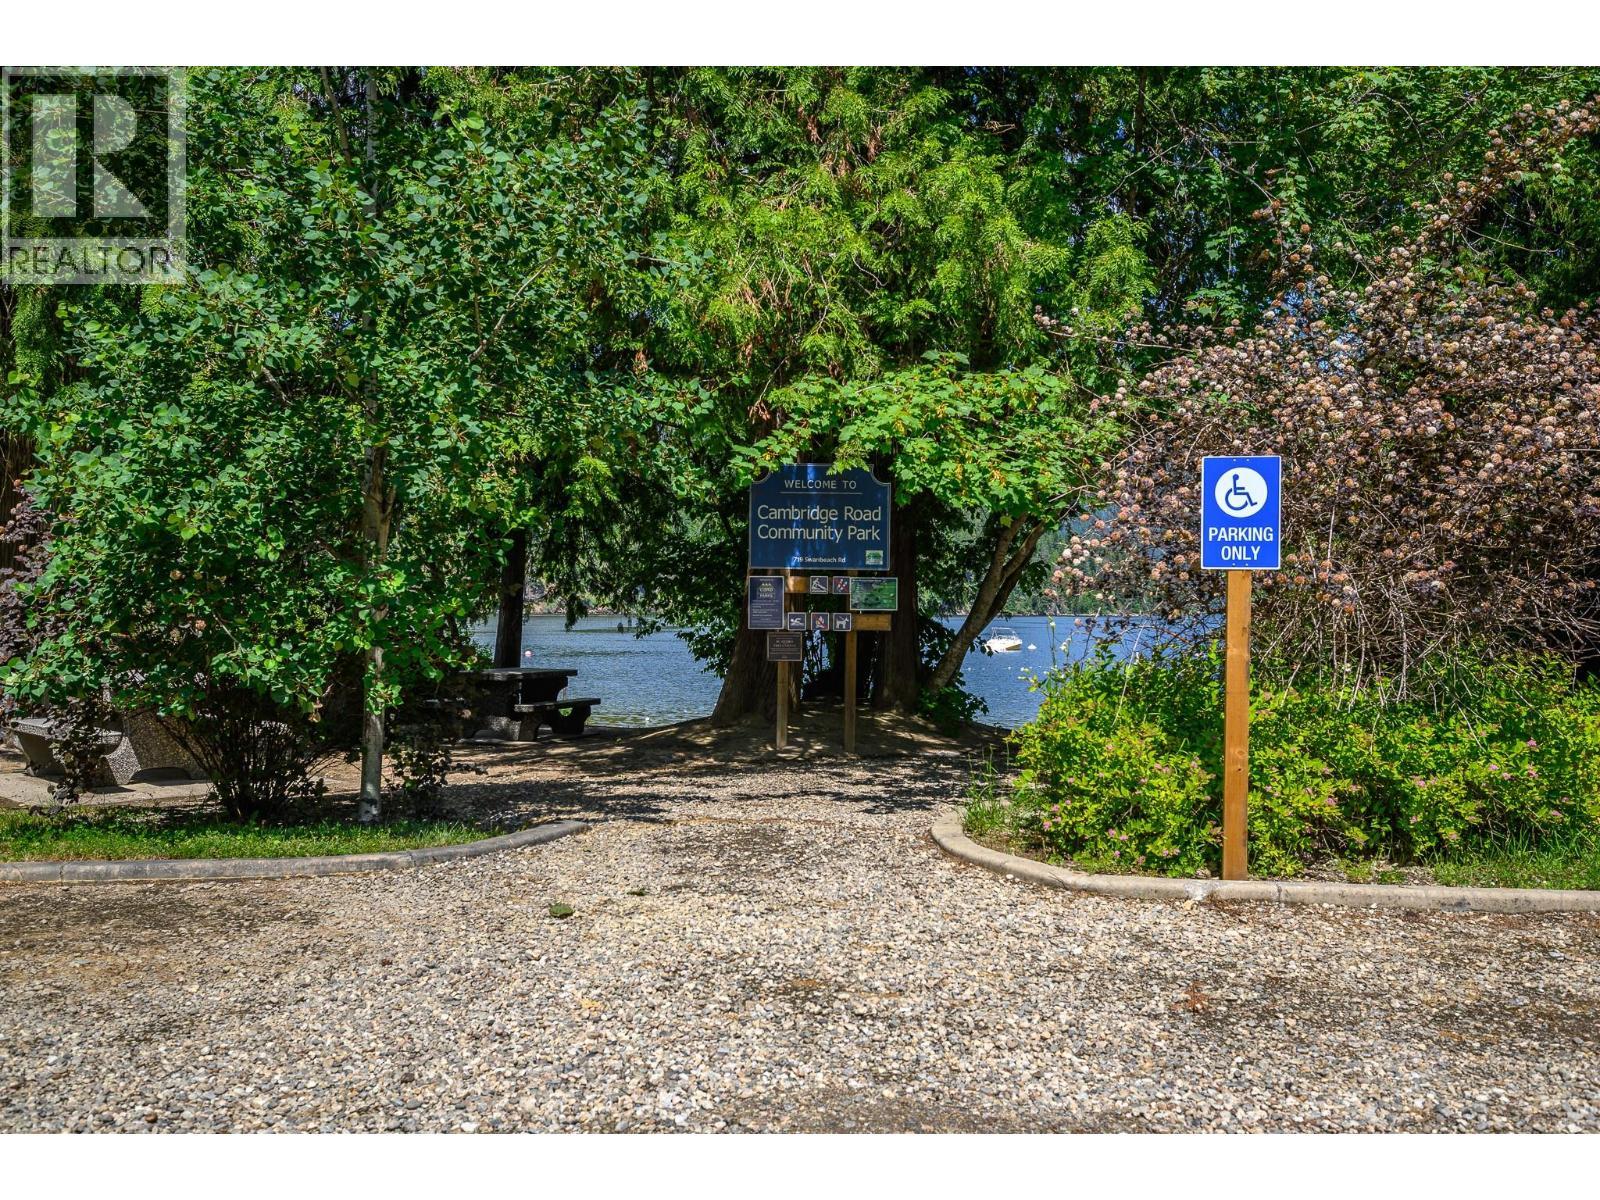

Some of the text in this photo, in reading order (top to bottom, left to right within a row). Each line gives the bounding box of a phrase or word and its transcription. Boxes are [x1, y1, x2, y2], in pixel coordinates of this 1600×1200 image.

[784, 479, 857, 490] WELCOME TO
[757, 504, 881, 524] Cambridge Road
[757, 524, 880, 543] Community Park
[1208, 526, 1274, 542] PARKING
[1221, 545, 1260, 561] ONLY
